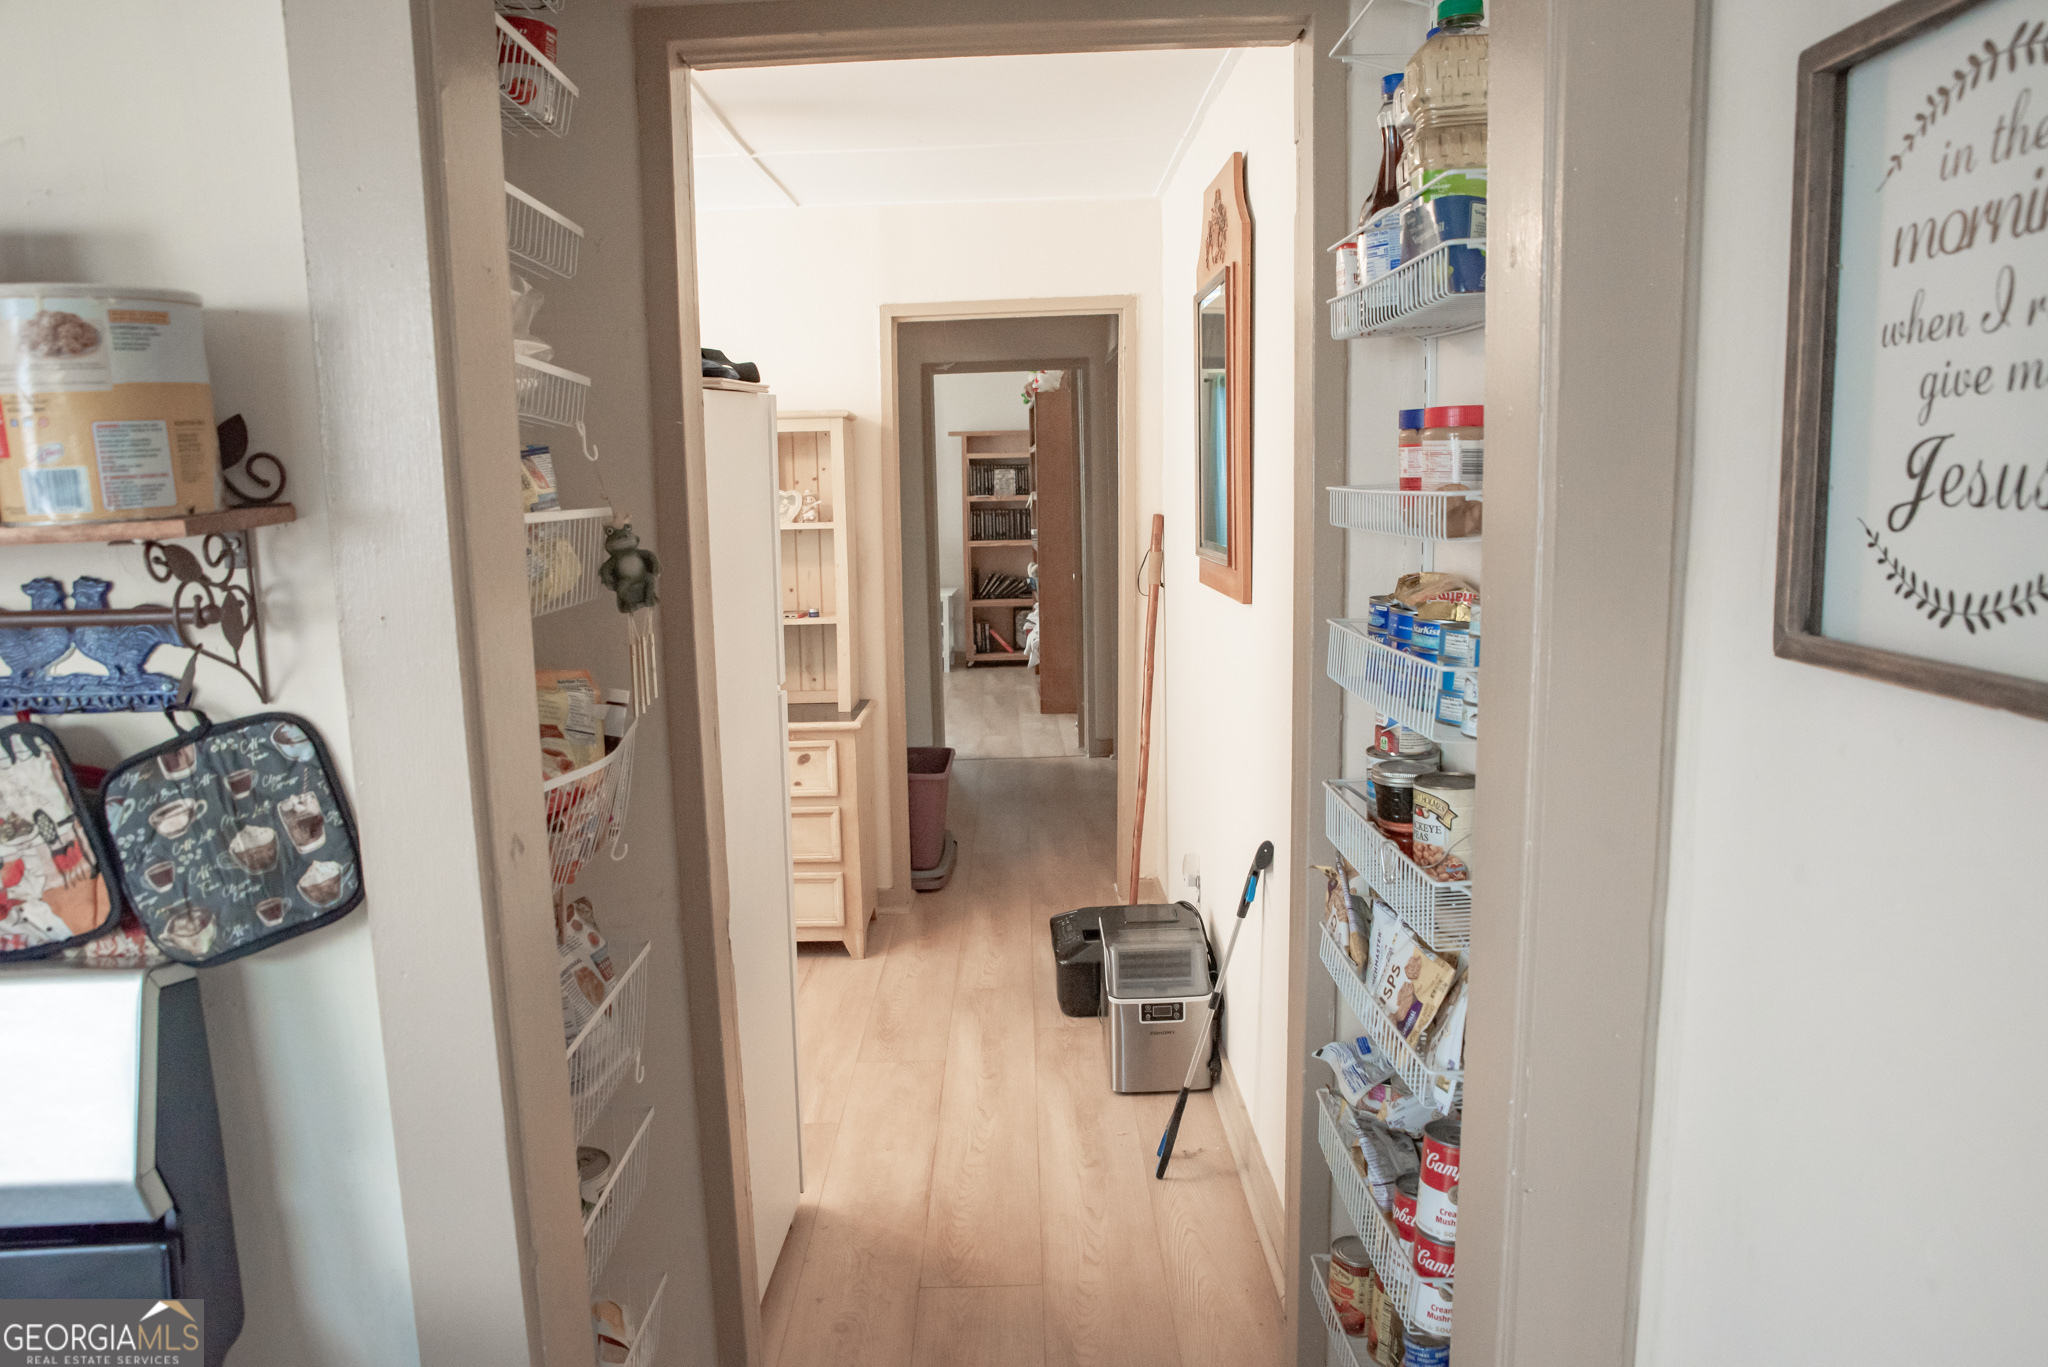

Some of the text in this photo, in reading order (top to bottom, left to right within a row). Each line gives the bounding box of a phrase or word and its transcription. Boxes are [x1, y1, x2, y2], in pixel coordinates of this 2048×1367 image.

[1940, 140, 1977, 181] in
[1881, 288, 1968, 348] when
[1917, 358, 2048, 426] give m
[1421, 795, 1446, 813] HOLMES
[1413, 821, 1442, 835] CKEYE
[1378, 964, 1401, 1007] ISPS
[1435, 1215, 1456, 1227] Mush
[1439, 1208, 1457, 1218] Crea
